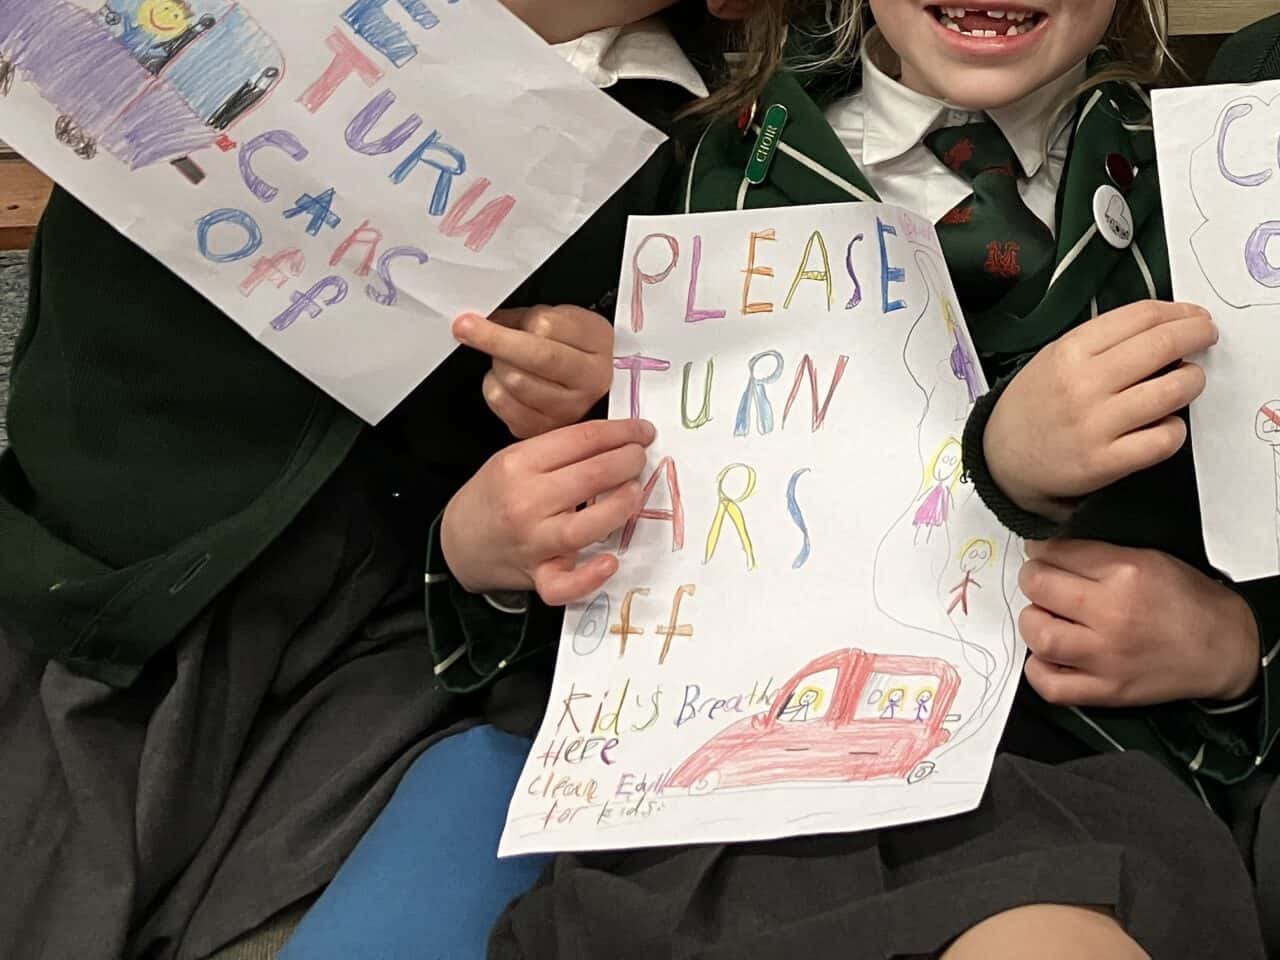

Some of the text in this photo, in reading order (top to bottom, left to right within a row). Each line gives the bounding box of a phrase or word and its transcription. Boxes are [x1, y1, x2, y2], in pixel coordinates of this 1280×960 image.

[297, 25, 518, 251] TURN
[755, 124, 778, 163] CHOIR
[238, 128, 430, 307] CARS
[633, 215, 907, 333] PLEASE
[613, 348, 850, 437] TURN
[617, 455, 813, 571] ARS
